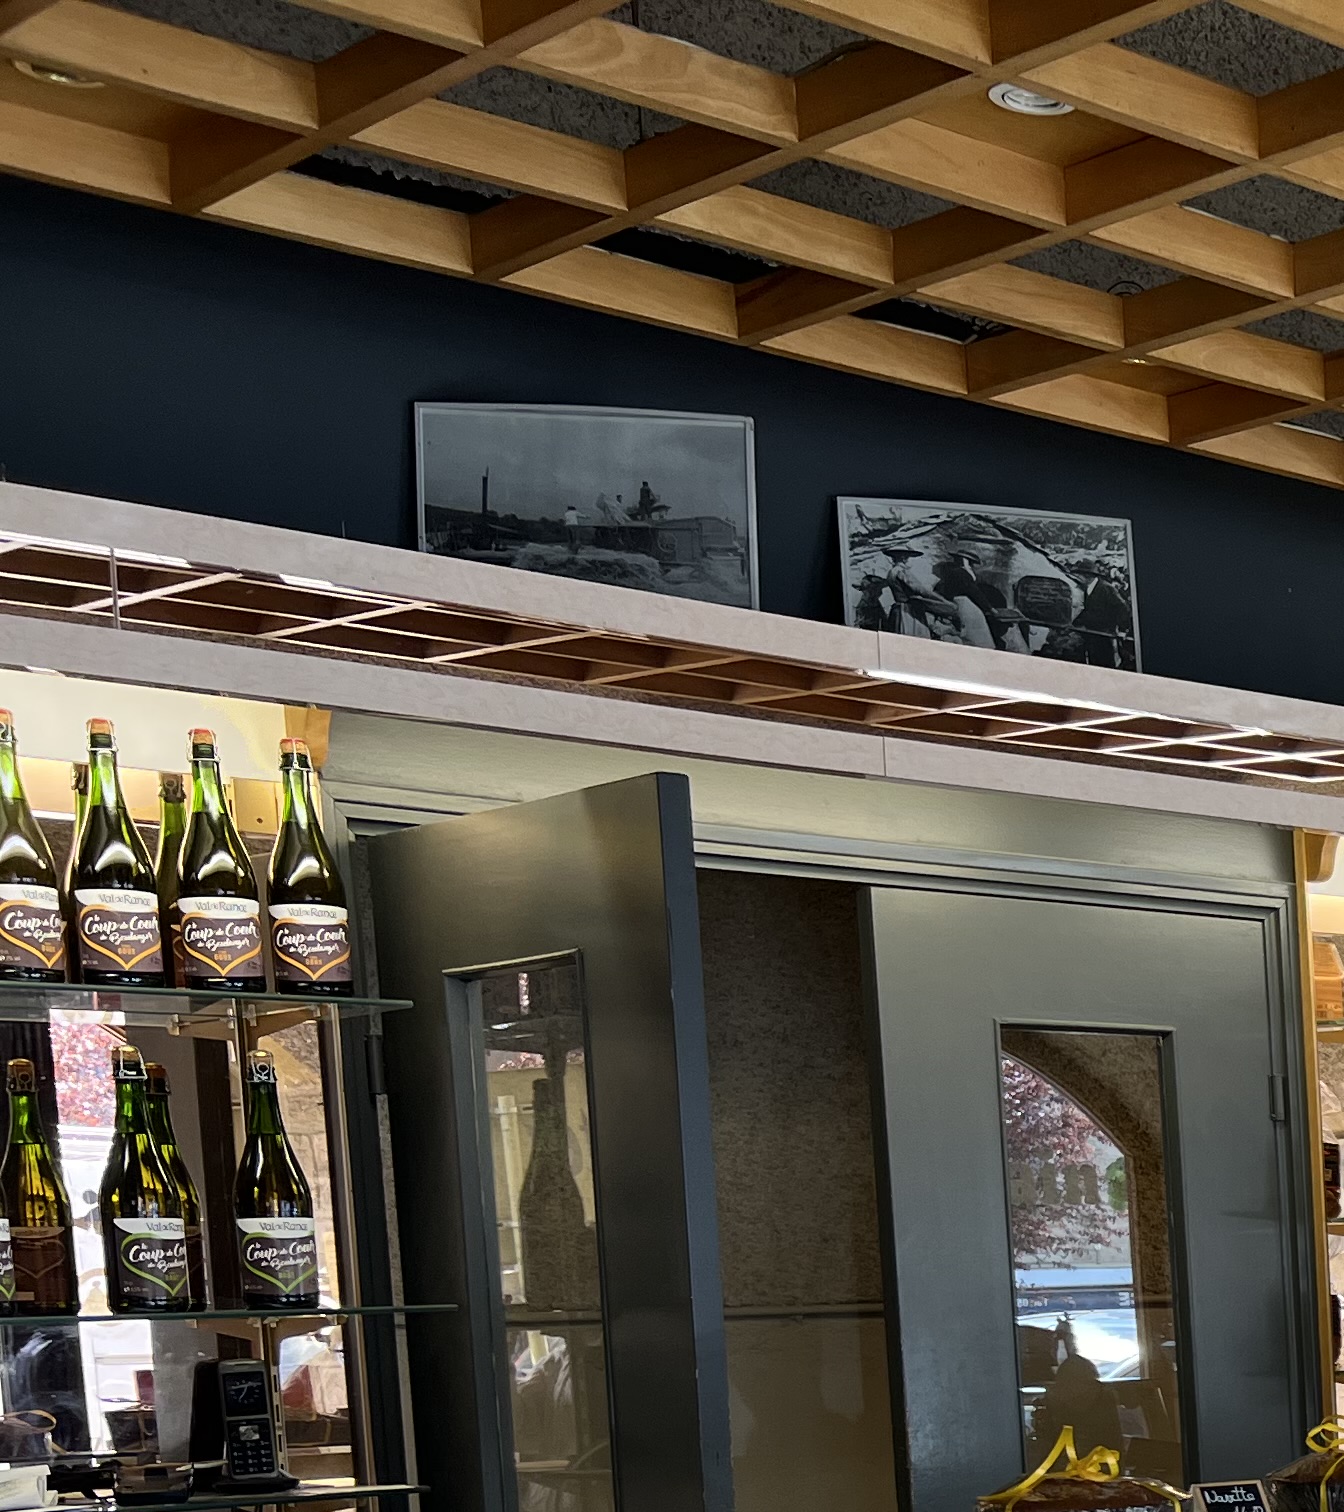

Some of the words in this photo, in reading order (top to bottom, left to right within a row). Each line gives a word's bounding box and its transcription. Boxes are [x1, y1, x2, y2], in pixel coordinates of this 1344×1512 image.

[195, 901, 212, 911] Val
[287, 908, 302, 916] Val
[4, 911, 41, 931] Coup
[85, 916, 118, 935] Coup
[185, 923, 213, 942] Coup
[276, 930, 305, 948] Coup
[129, 1244, 165, 1263] Coup
[247, 1244, 277, 1262] Coup
